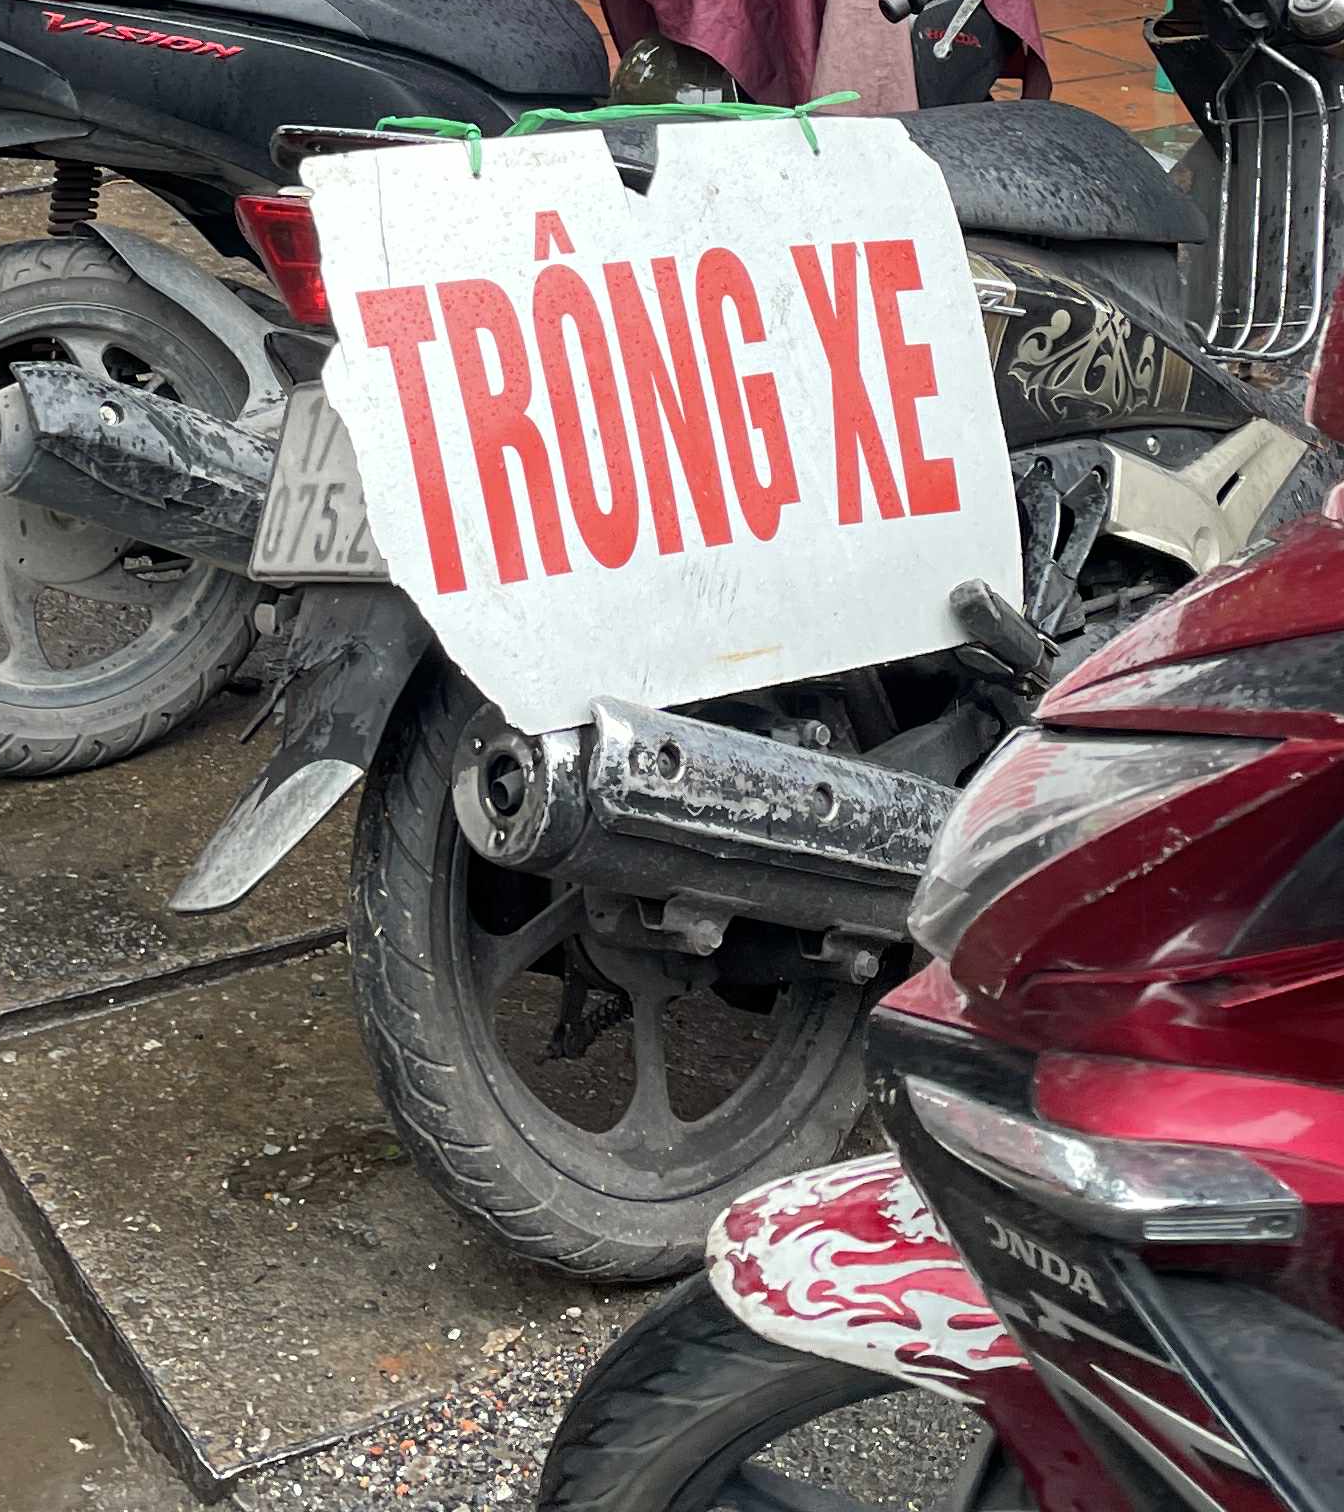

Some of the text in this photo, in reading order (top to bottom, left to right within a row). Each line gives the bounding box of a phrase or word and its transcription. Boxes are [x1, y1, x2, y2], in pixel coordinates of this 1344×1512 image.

[42, 11, 245, 59] VISION
[355, 210, 961, 595] TRÔNG XE
